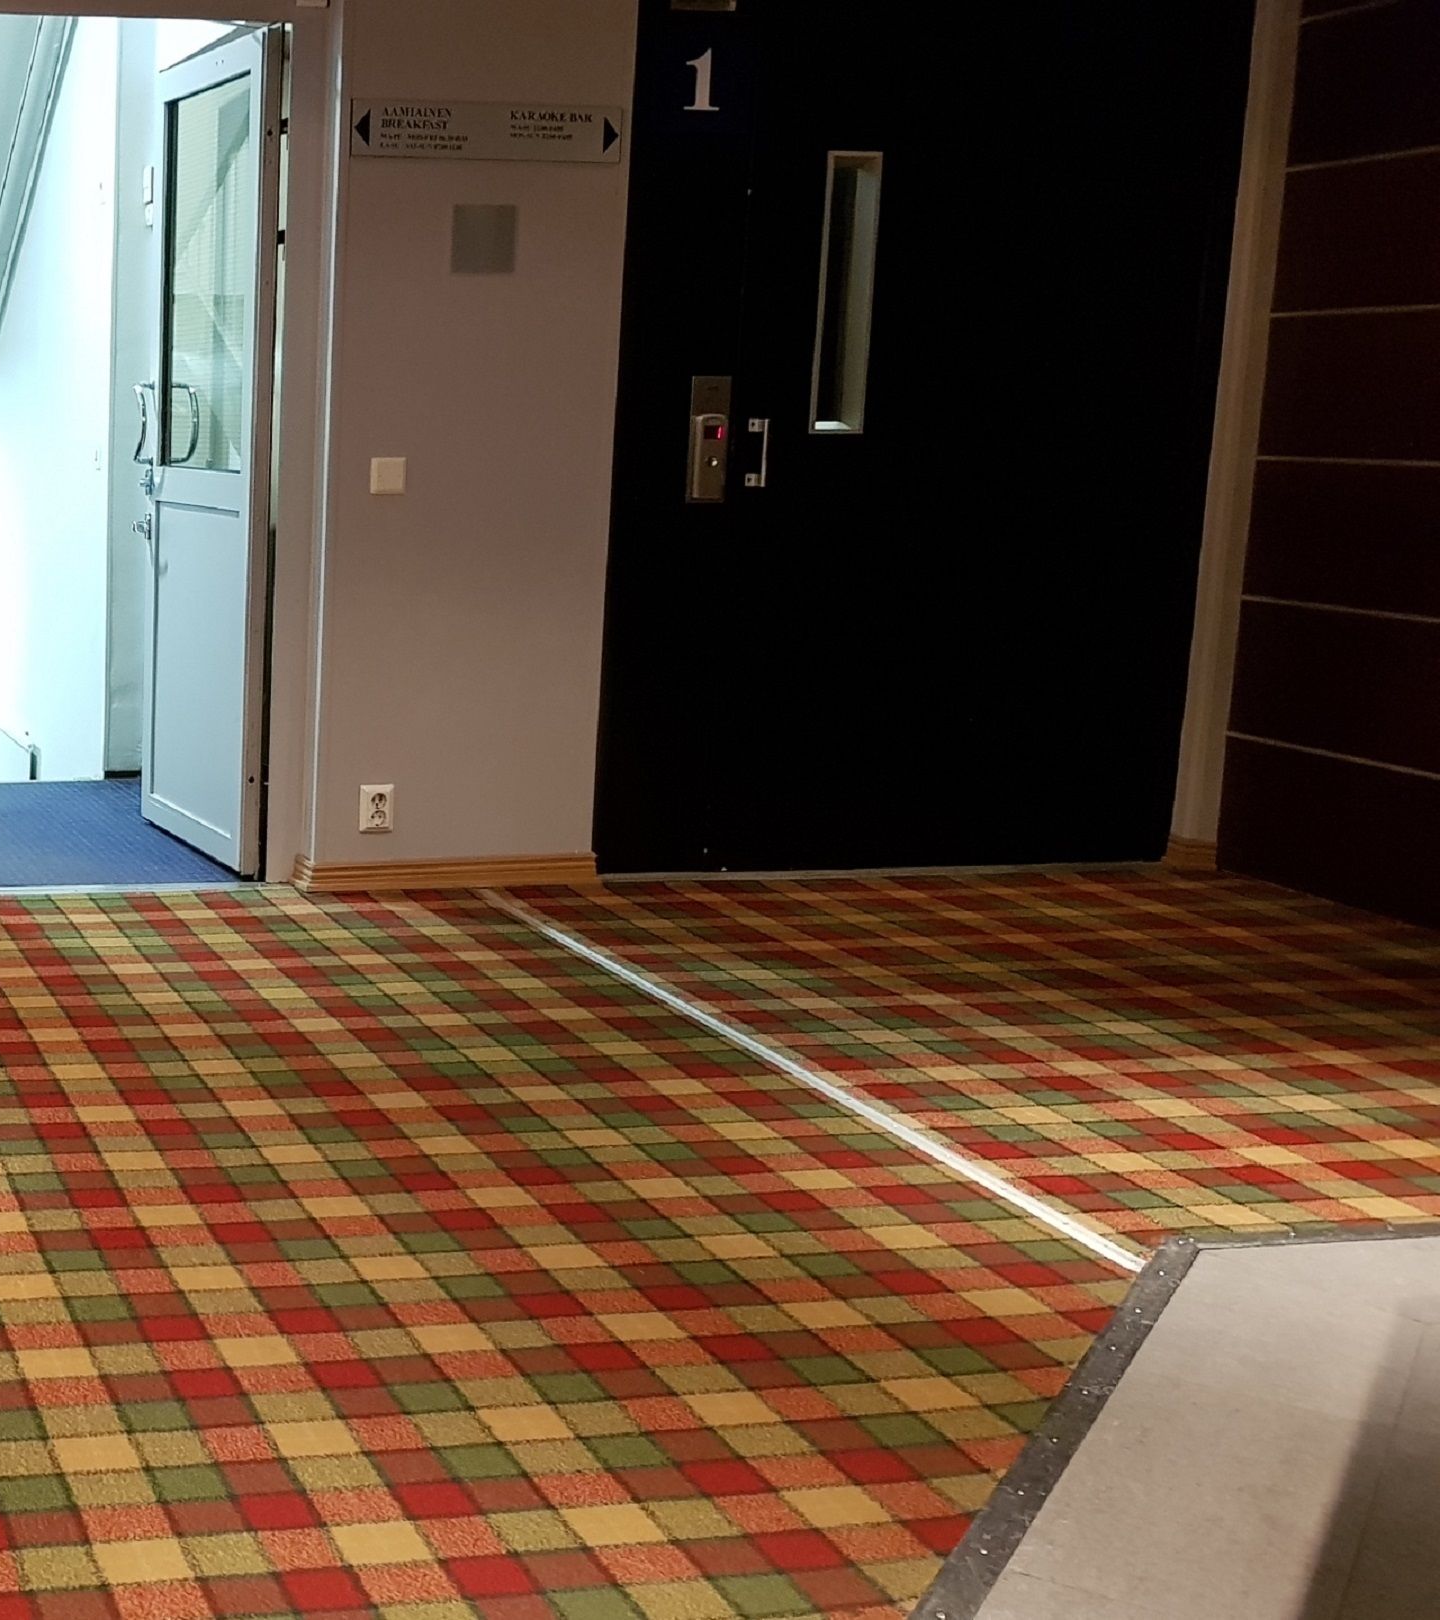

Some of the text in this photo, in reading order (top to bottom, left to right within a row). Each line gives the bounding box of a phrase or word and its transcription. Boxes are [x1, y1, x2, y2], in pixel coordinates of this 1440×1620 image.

[682, 46, 721, 111] 1
[382, 106, 453, 119] AAMIAINEN
[510, 110, 593, 123] KARAOKE BAR
[380, 118, 449, 130] BREAKFAST
